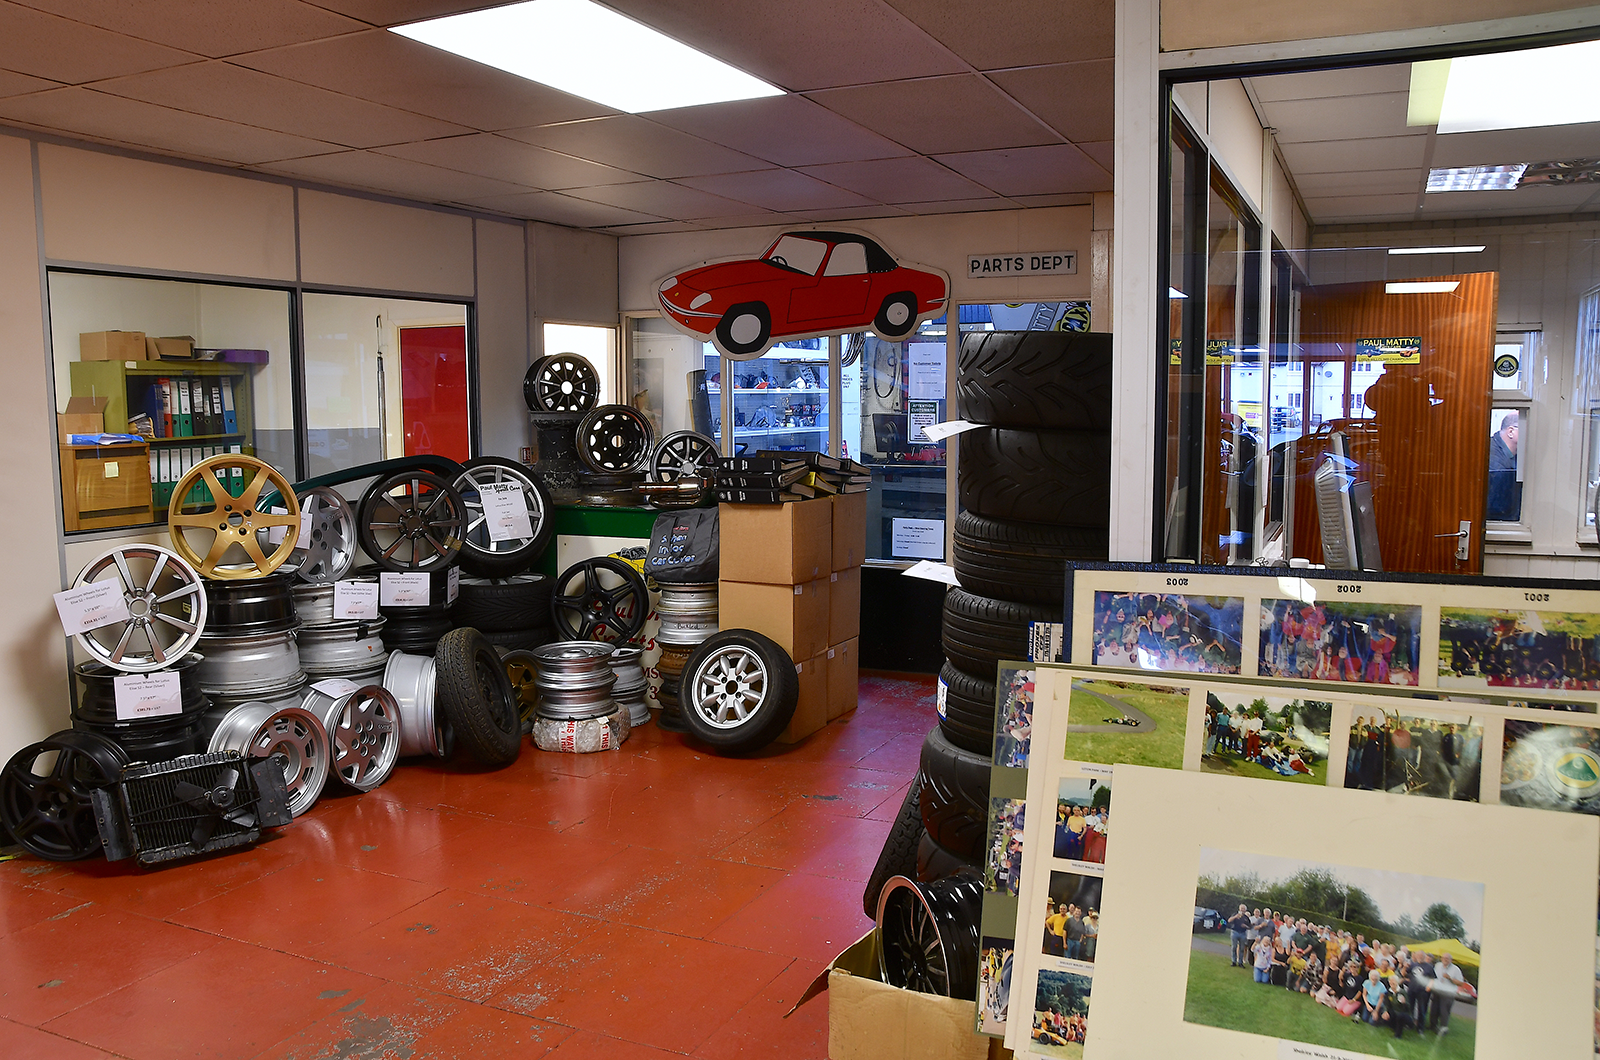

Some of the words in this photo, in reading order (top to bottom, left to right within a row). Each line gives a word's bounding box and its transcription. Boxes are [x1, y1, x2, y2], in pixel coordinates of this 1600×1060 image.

[971, 257, 1024, 273] PARTS
[1030, 255, 1074, 270] DEPT
[1363, 339, 1384, 347] PAUL
[1386, 338, 1415, 346] MATTY
[1166, 578, 1189, 586] 2003
[1337, 585, 1361, 593] 2002
[1524, 593, 1549, 601] 2001
[566, 720, 575, 734] HIS
